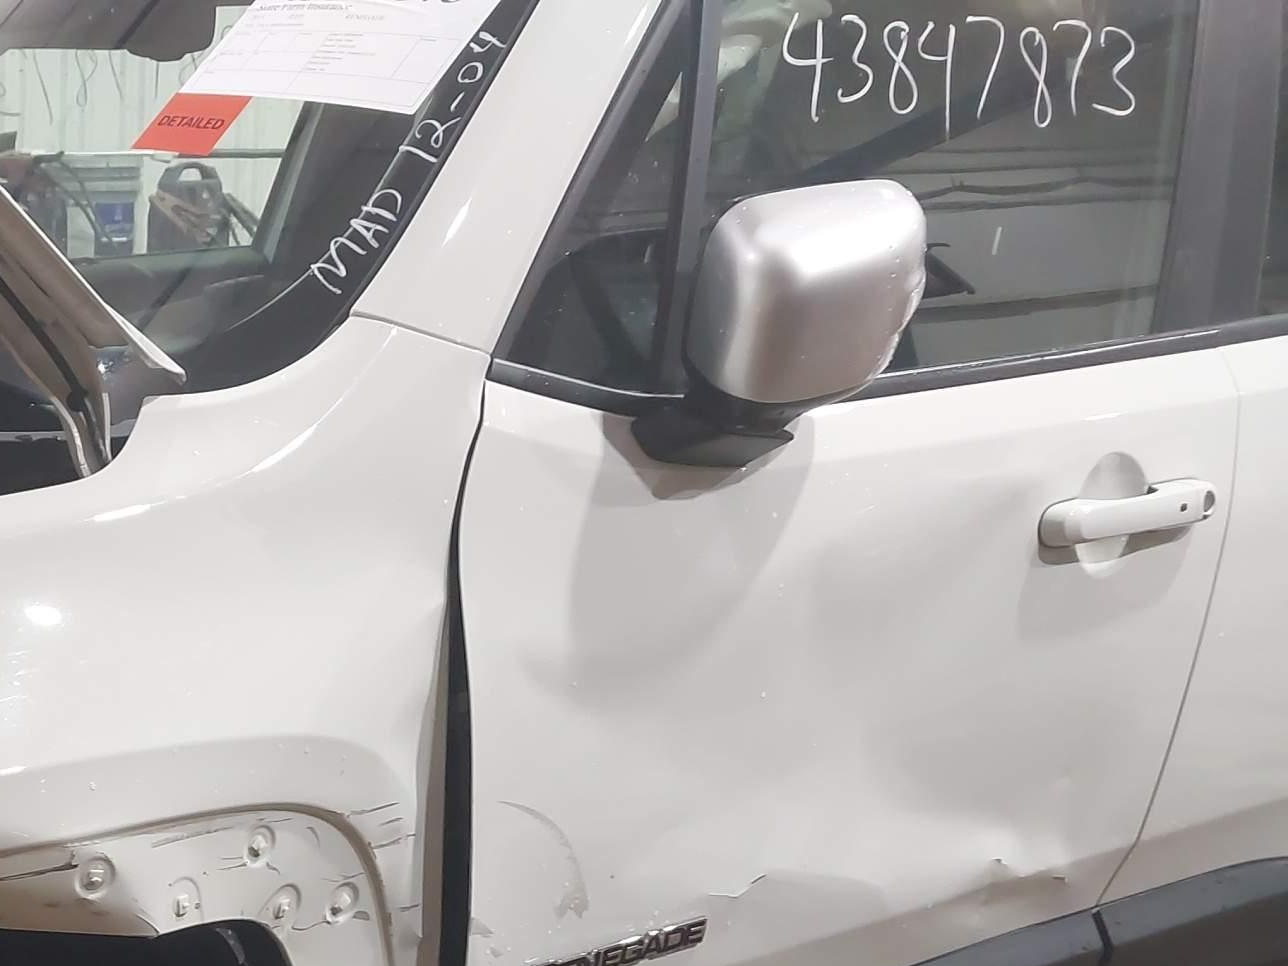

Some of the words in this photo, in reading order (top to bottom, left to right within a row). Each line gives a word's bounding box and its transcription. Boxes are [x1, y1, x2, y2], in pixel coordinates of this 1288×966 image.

[157, 115, 226, 130] DETAILED
[782, 12, 1136, 141] 43847873
[310, 188, 402, 294] MAD
[399, 31, 509, 163] 12-04
